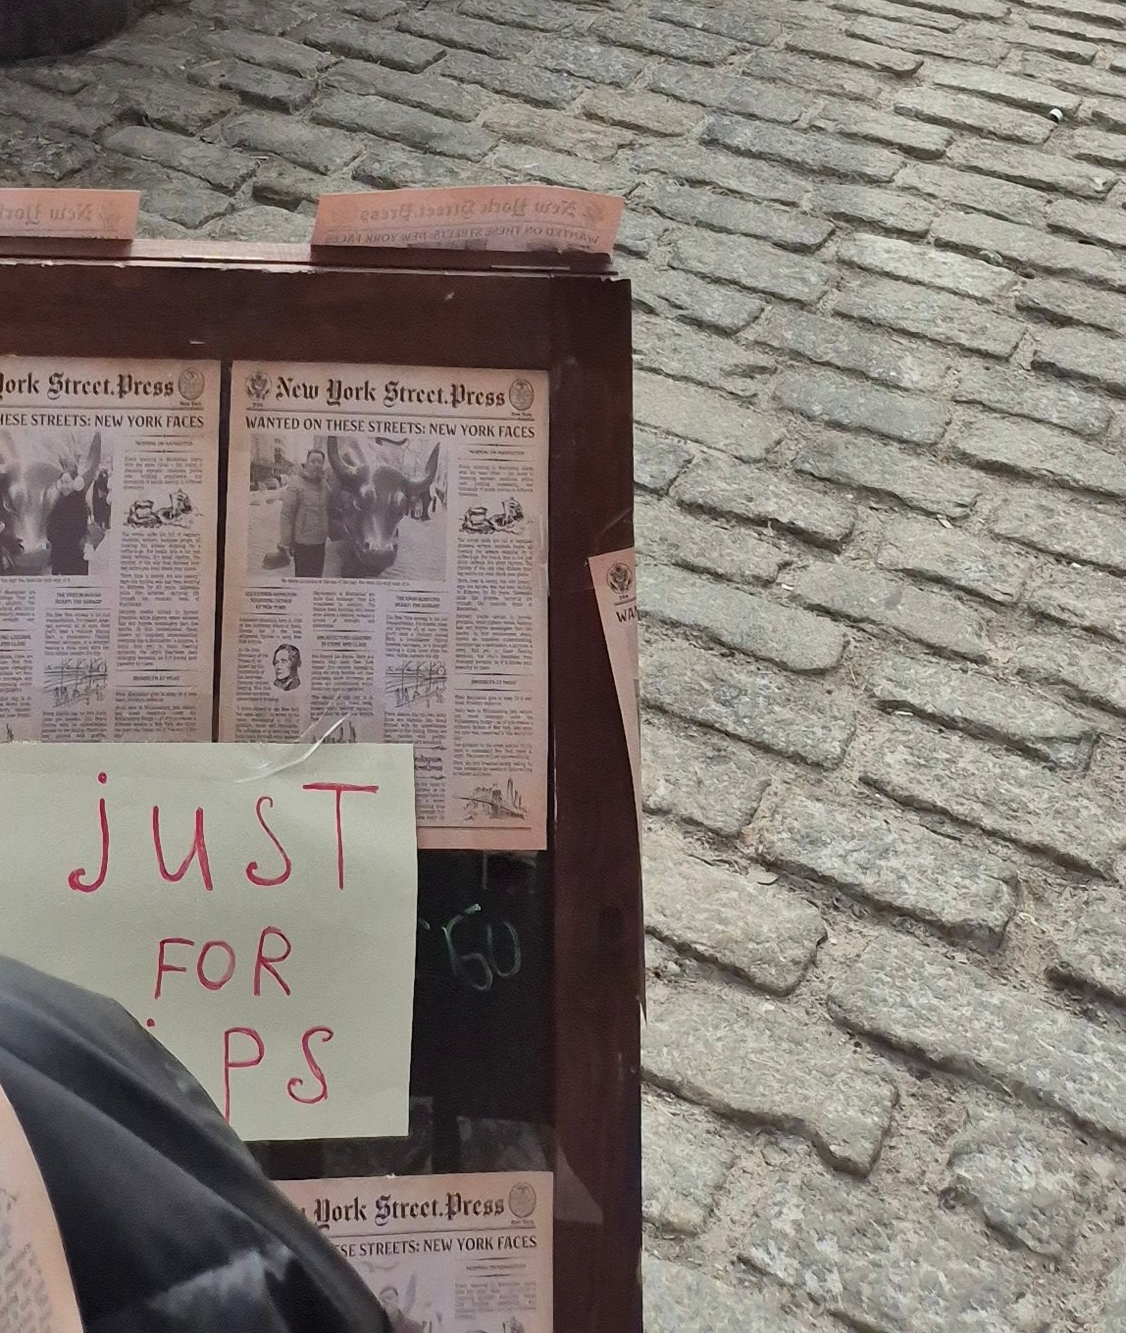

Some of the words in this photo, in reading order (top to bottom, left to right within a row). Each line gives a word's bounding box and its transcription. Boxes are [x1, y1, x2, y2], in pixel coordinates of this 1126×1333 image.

[276, 376, 319, 400] New
[325, 377, 376, 406] York
[30, 414, 92, 428] STREETS:
[94, 414, 124, 428] NEW
[127, 415, 163, 428] YORK
[166, 415, 204, 429] FACES
[245, 416, 300, 430] WANTED
[303, 417, 323, 431] ON
[325, 418, 365, 432] THESE
[368, 419, 427, 434] STREETS:
[429, 422, 458, 436] NEW
[461, 423, 496, 437] YORK
[499, 424, 535, 438] FACES
[154, 925, 291, 1000] FOR
[314, 1196, 368, 1230] York
[359, 1241, 421, 1257] STREETS:
[423, 1239, 454, 1253] NEW
[457, 1237, 494, 1251] YORK
[497, 1235, 538, 1249] FACES
